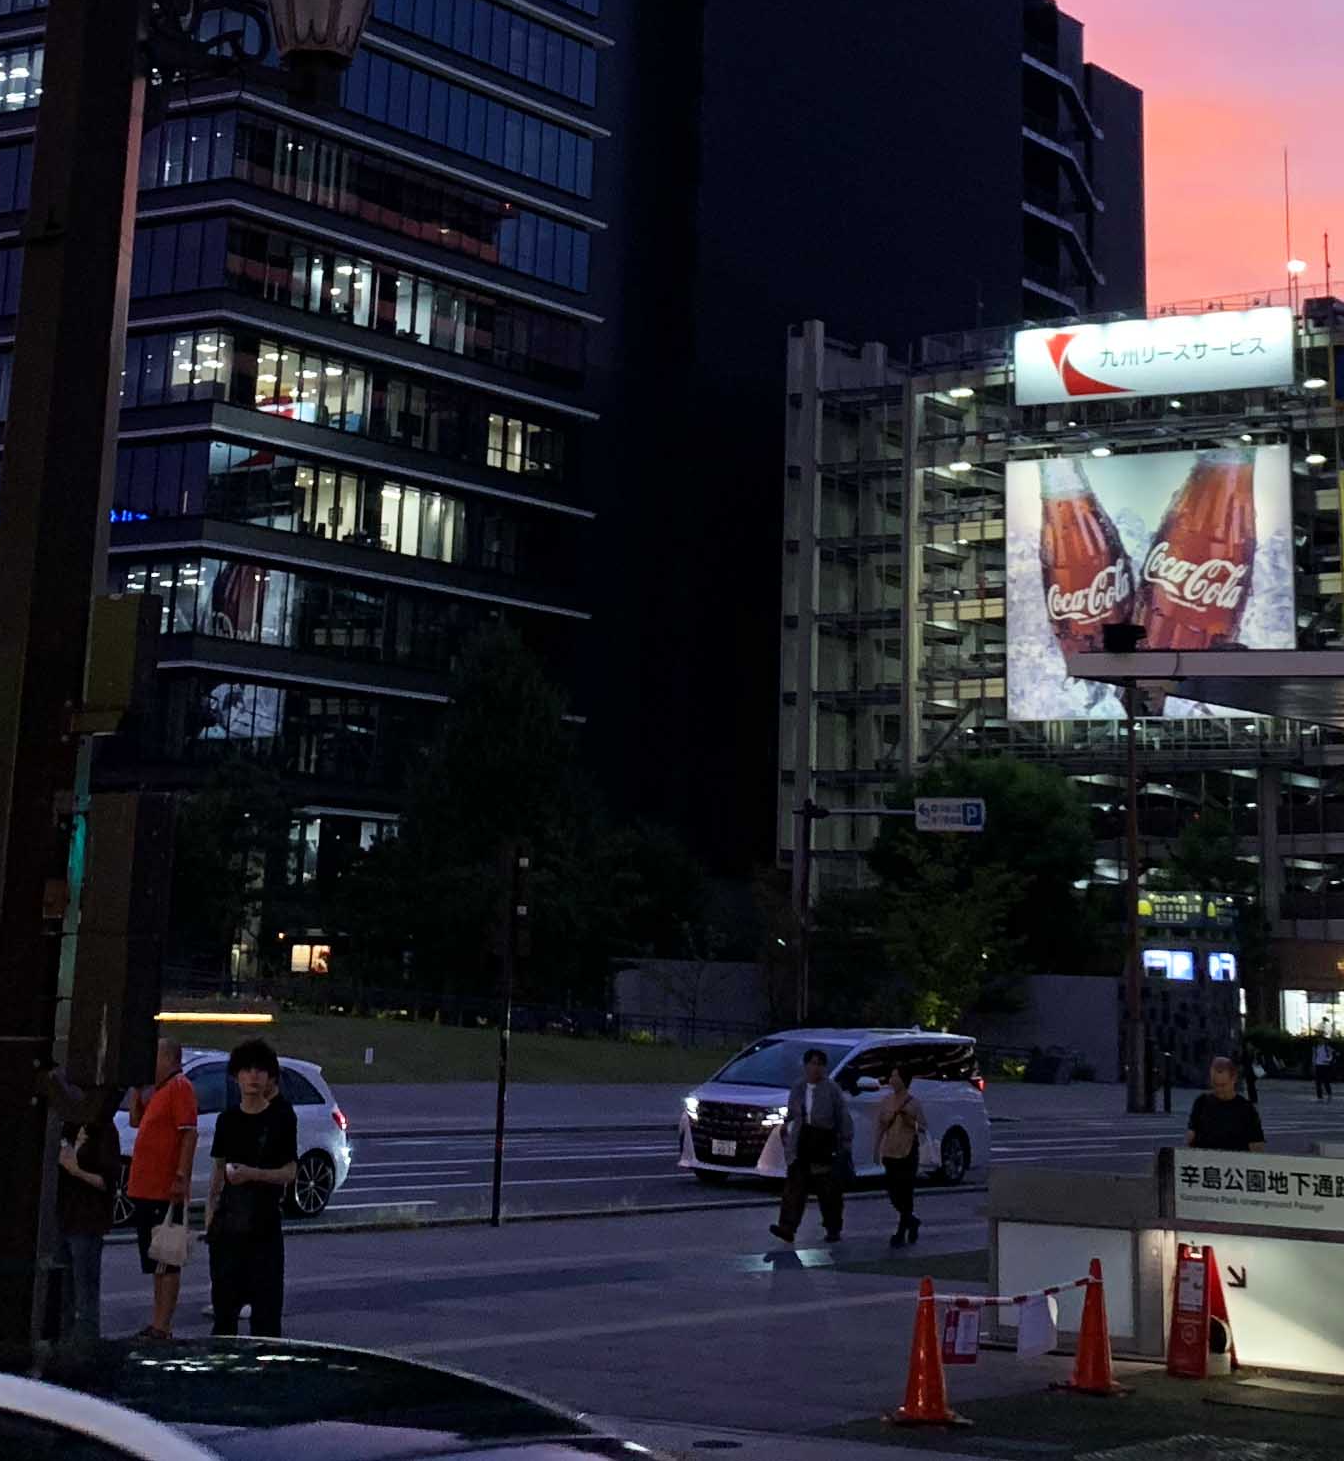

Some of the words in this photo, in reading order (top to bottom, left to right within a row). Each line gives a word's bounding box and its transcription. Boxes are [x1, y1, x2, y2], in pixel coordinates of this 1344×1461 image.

[1099, 338, 1266, 368] 九州リースサービス
